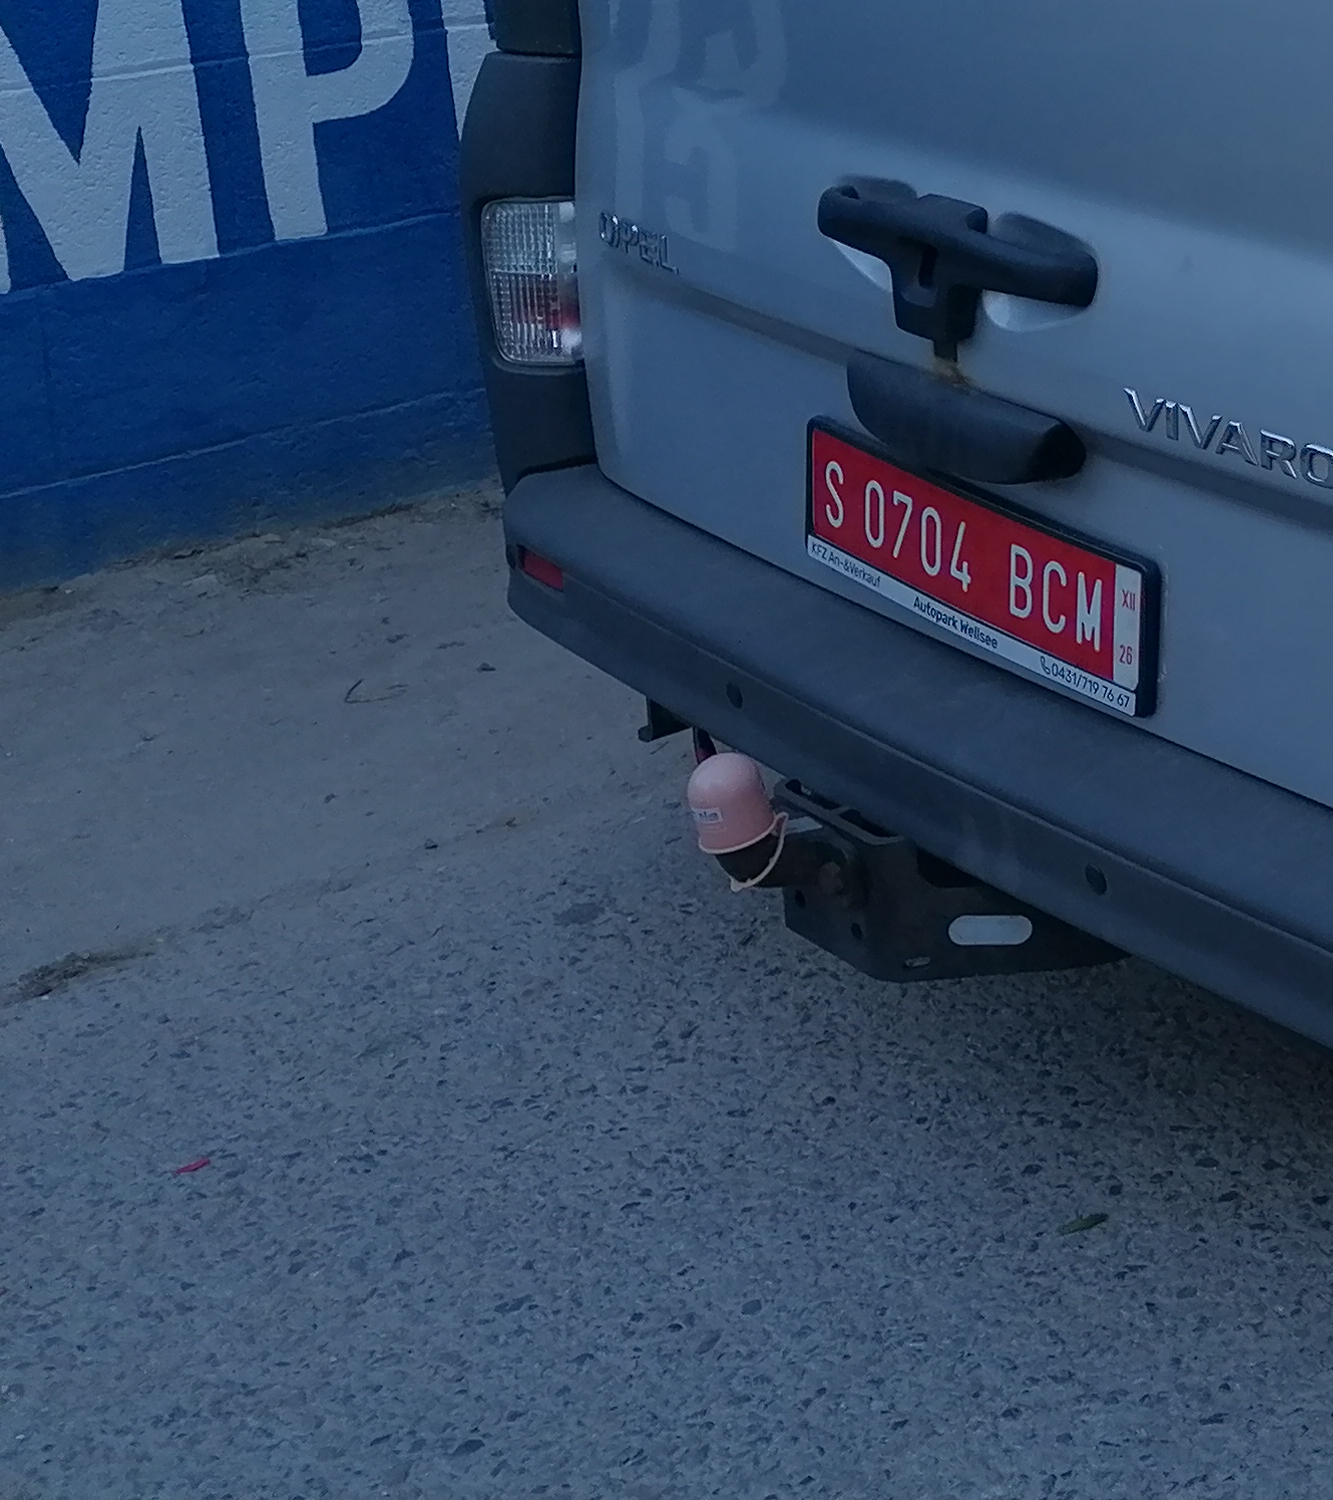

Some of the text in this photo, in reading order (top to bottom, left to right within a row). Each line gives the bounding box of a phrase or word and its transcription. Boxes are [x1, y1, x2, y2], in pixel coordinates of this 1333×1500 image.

[600, 212, 680, 275] OPEL
[811, 541, 828, 563] KFZ
[825, 461, 1103, 653] S 0704 BCM
[913, 596, 998, 649] Autopark Wellsee
[1121, 589, 1136, 611] XII
[1119, 644, 1133, 665] 26
[1051, 662, 1130, 708] 0431/719 76 67
